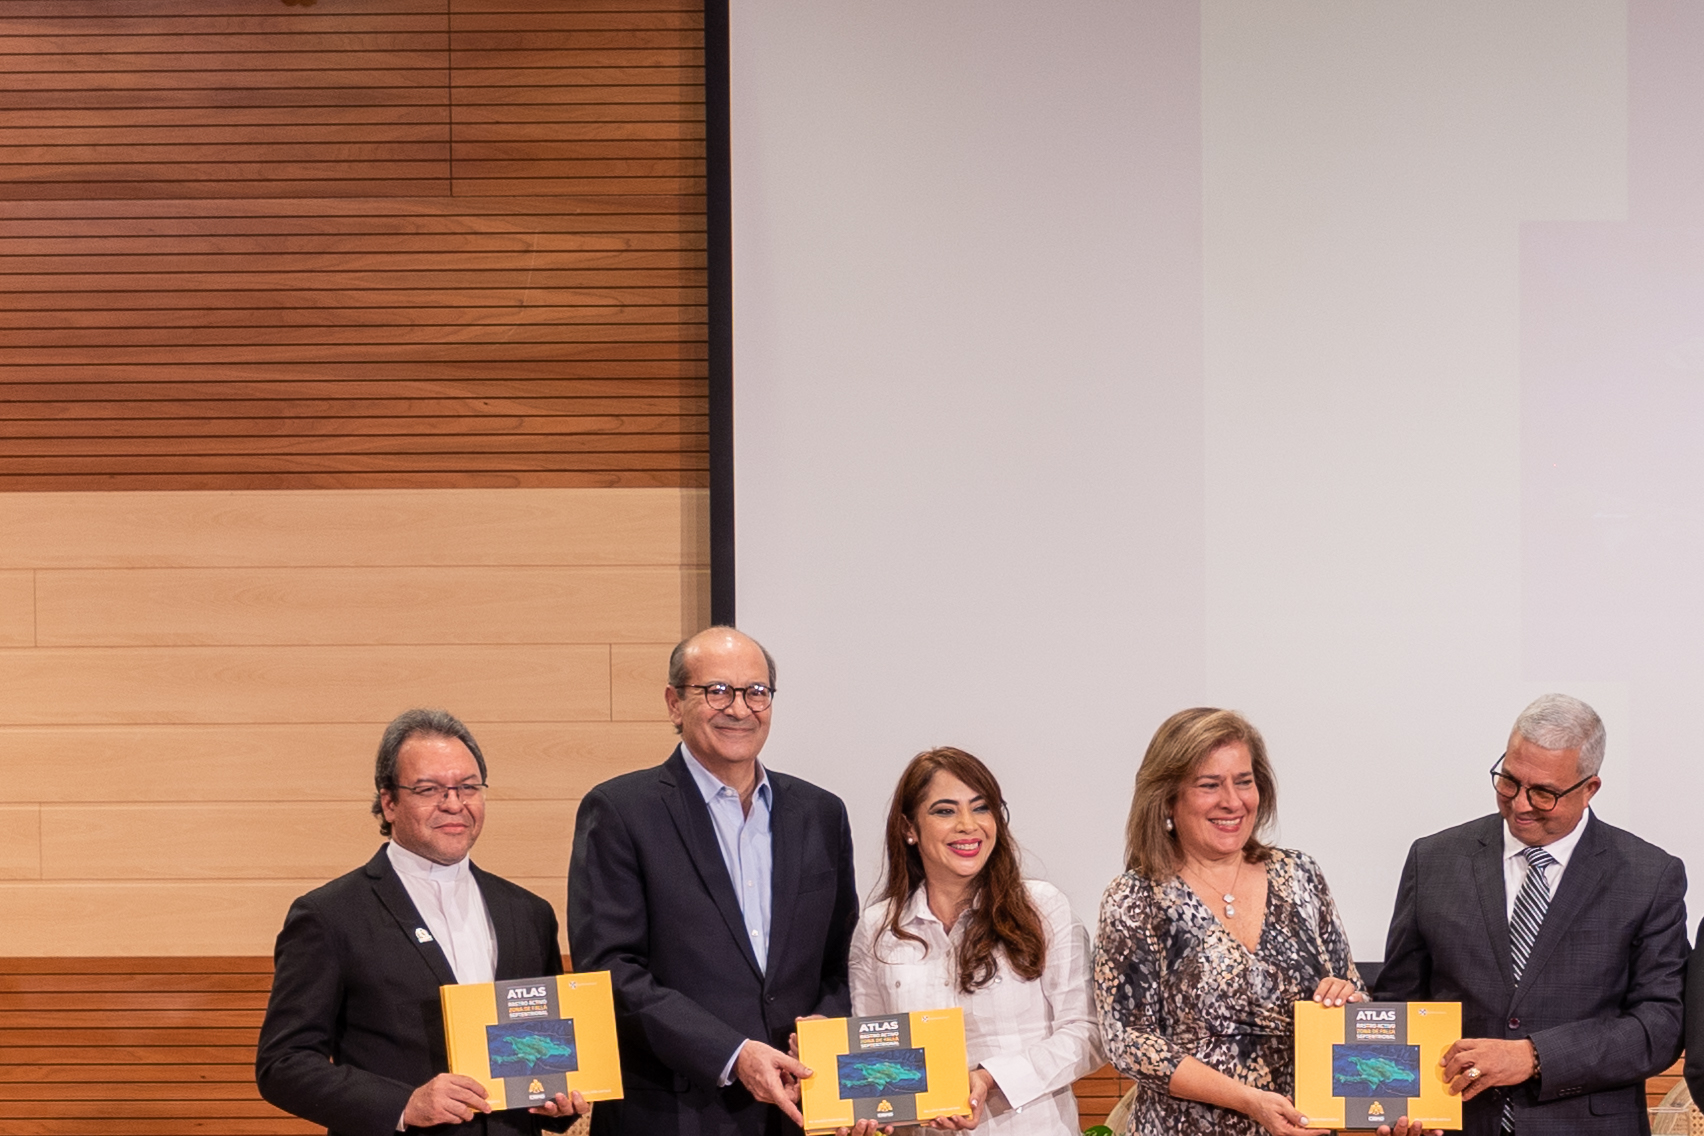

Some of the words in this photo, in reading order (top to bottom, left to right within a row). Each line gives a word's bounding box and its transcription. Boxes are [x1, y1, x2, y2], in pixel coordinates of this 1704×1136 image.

[507, 987, 547, 999] ATLAS
[1356, 1011, 1396, 1021] ATLAS
[859, 1022, 899, 1032] ATLAS
